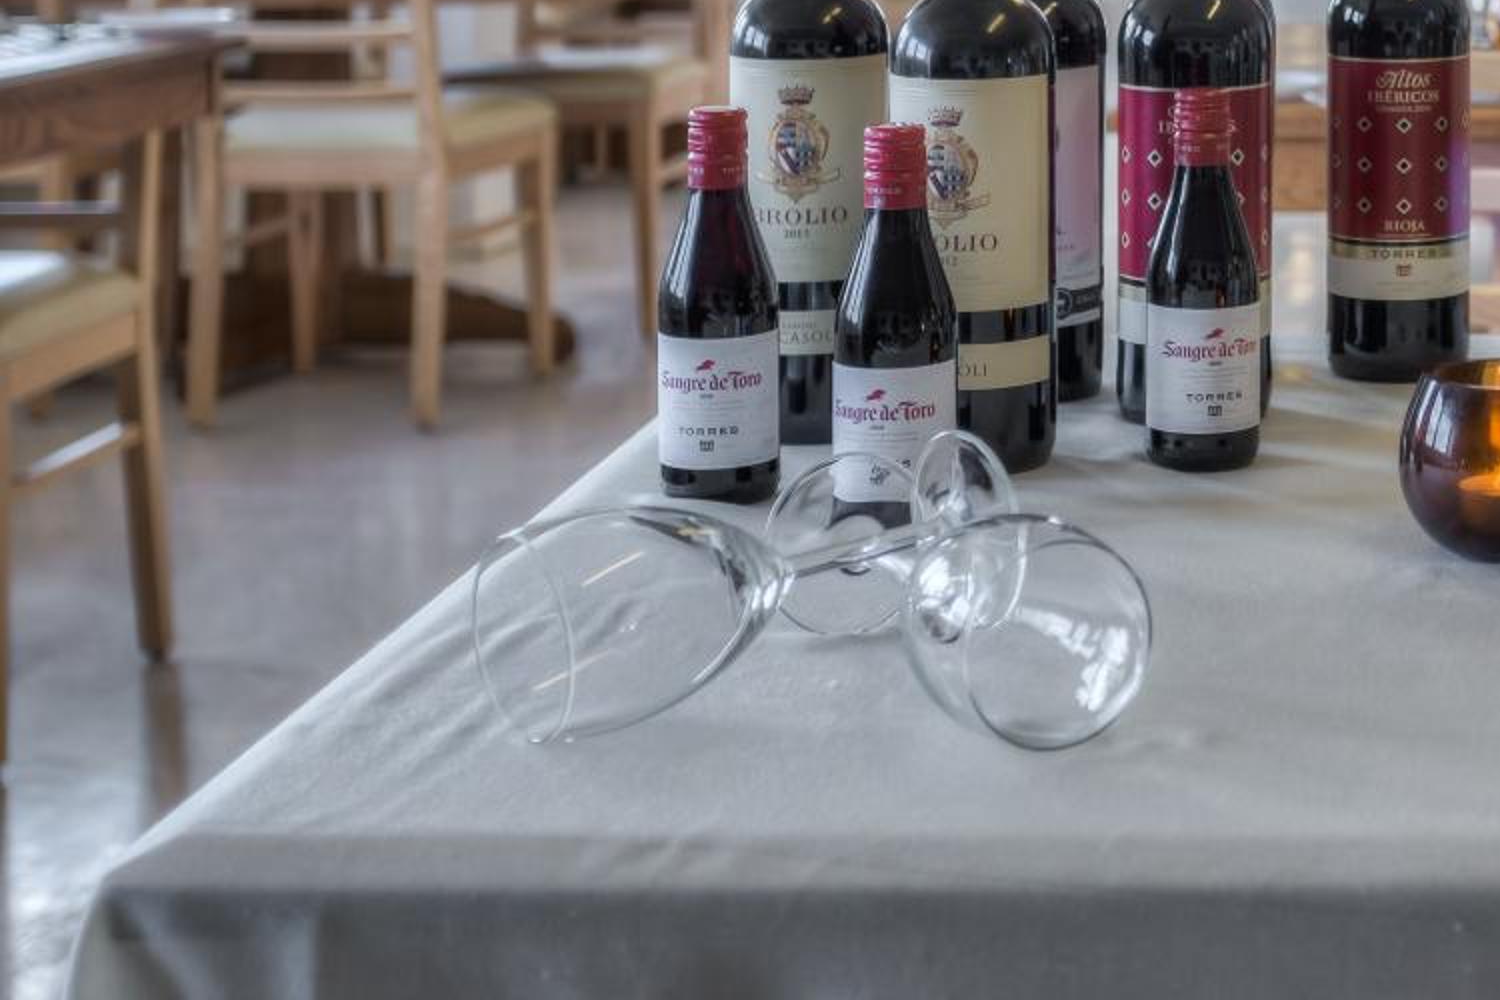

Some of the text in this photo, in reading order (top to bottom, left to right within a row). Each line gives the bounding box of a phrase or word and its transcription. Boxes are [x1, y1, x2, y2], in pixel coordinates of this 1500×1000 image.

[1218, 341, 1235, 357] de
[709, 374, 728, 391] de
[728, 371, 762, 390] Toro
[879, 404, 899, 421] de
[898, 401, 936, 420] Toro
